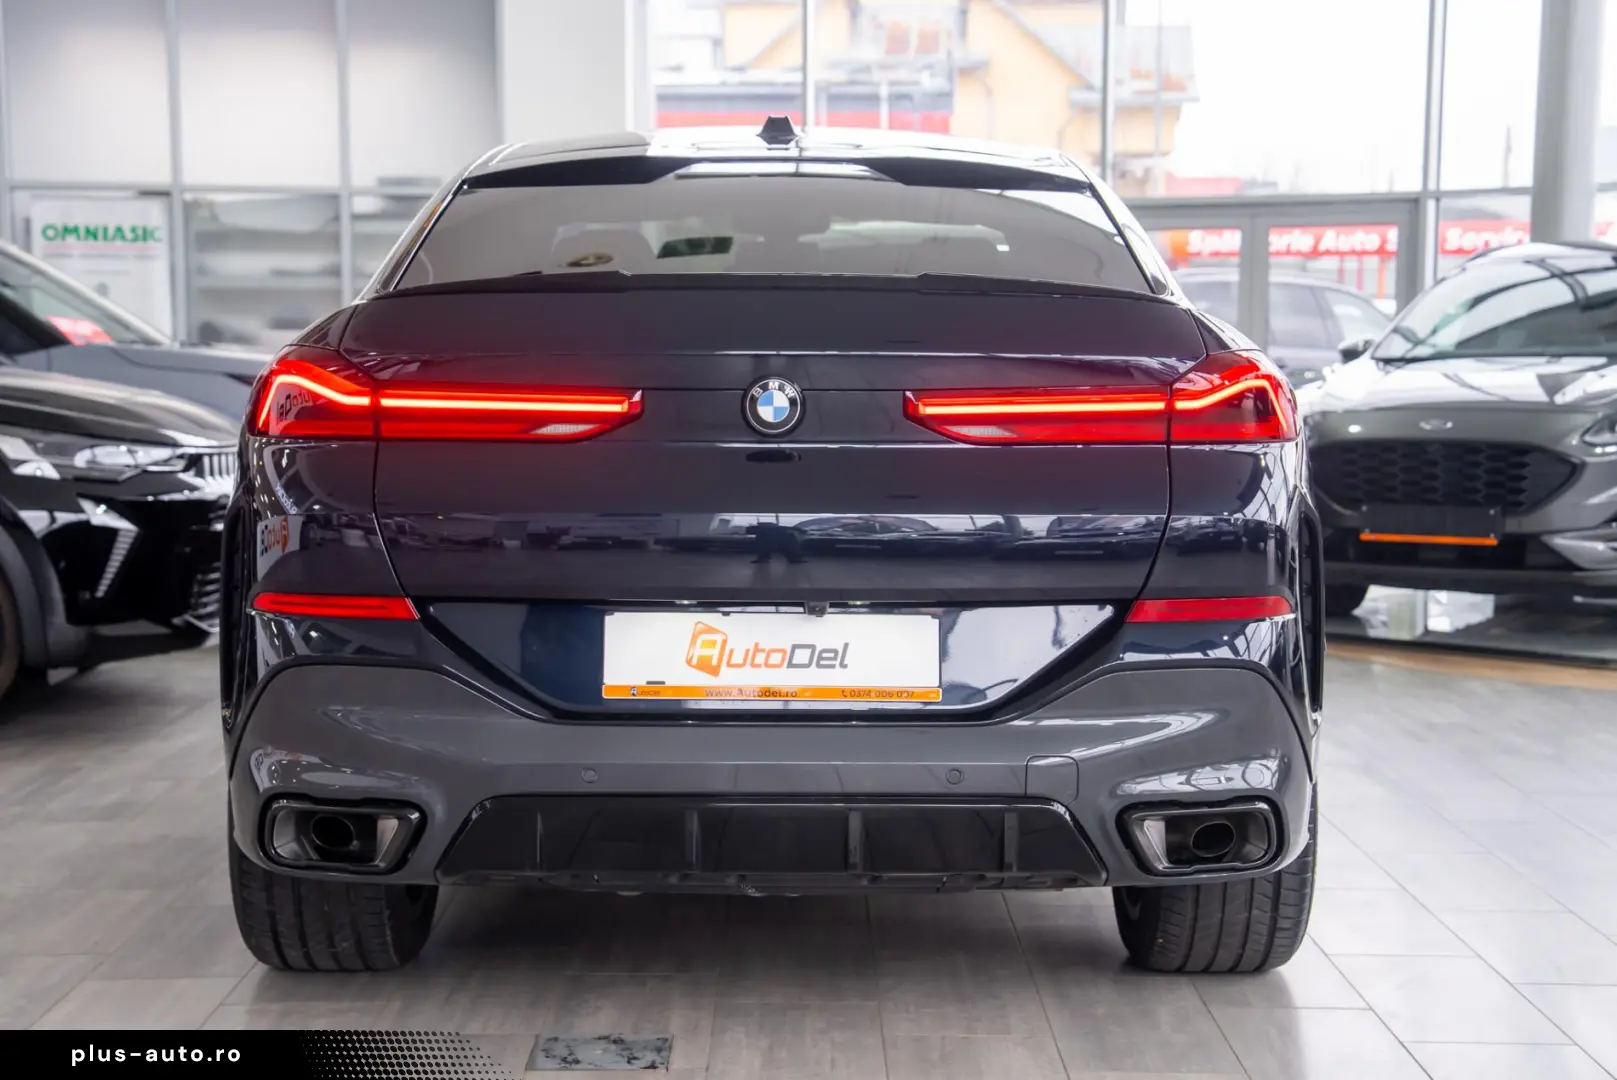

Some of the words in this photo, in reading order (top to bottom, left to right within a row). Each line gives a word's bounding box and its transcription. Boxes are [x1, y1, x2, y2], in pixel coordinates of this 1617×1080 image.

[1318, 229, 1381, 253] Auto
[752, 381, 796, 398] BMW
[689, 630, 848, 671] AutoDel
